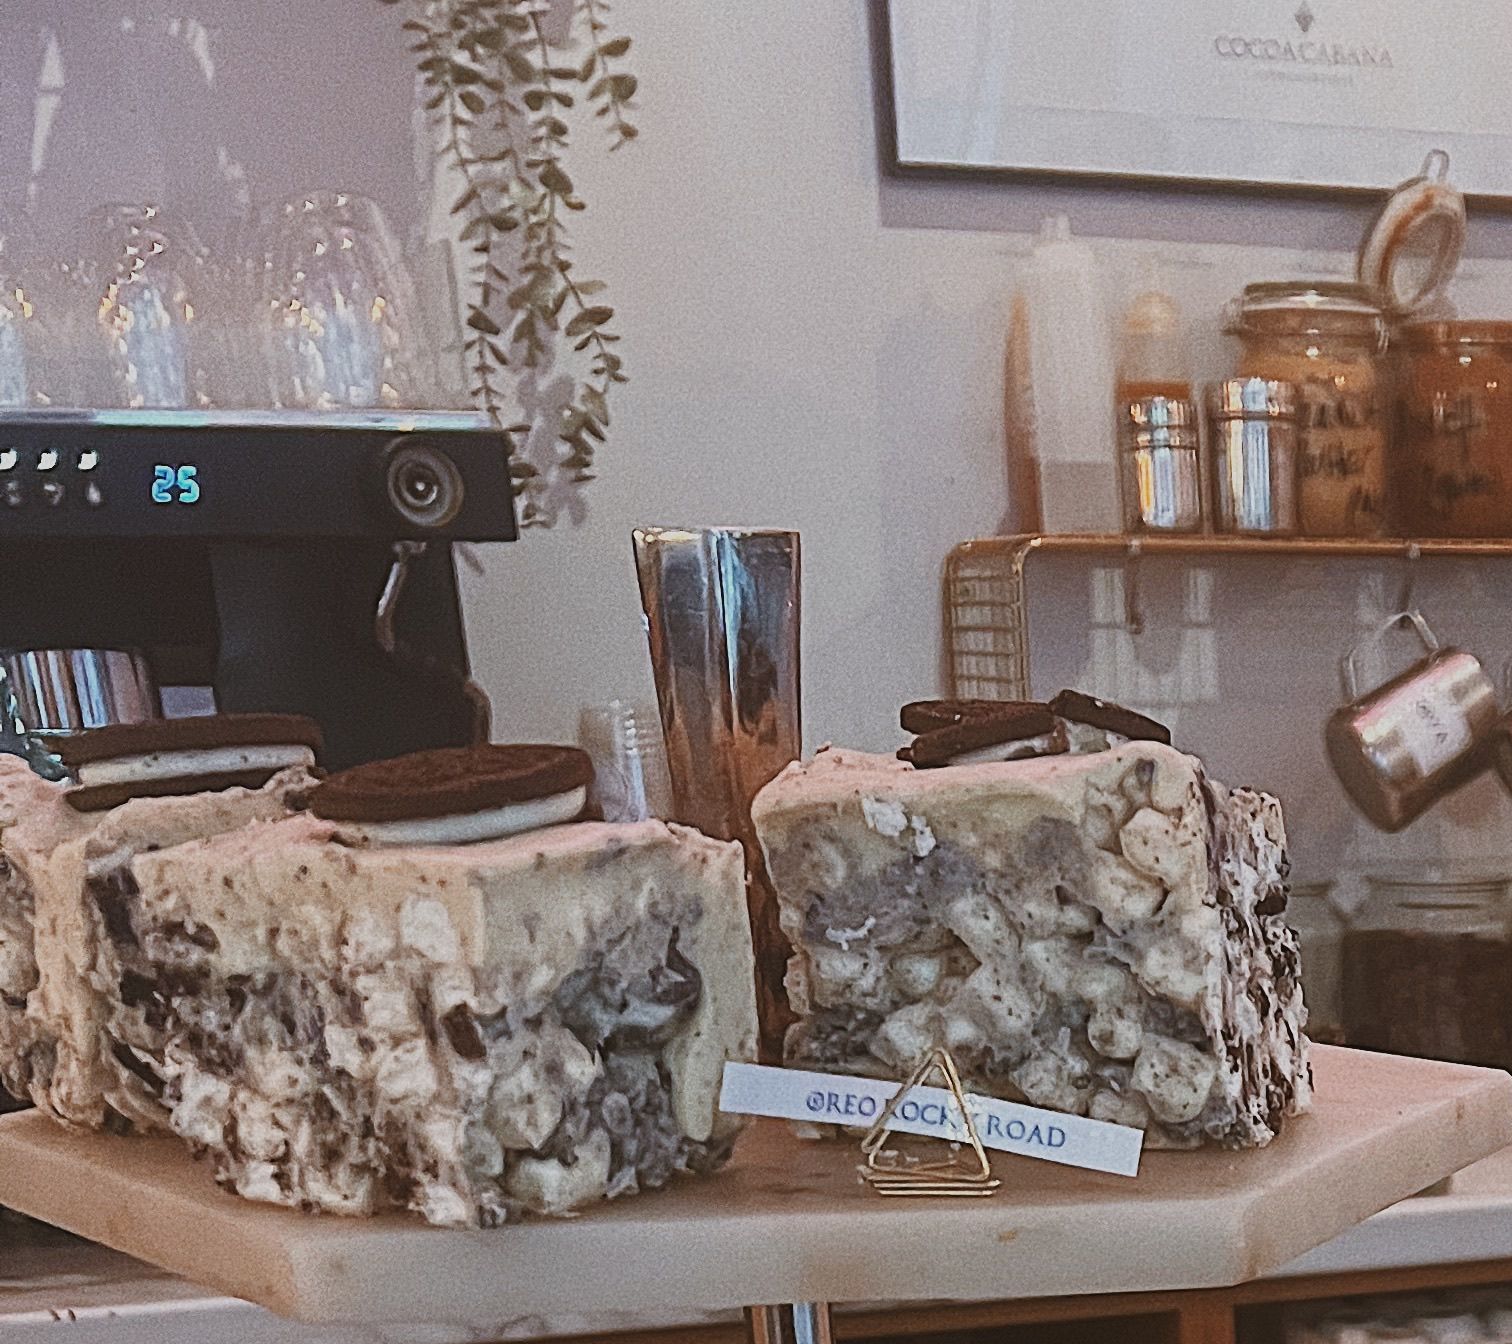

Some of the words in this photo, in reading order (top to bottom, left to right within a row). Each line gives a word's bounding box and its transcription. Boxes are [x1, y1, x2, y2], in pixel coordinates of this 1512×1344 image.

[151, 464, 200, 503] 25
[885, 1098, 980, 1131] OCK
[986, 1114, 1067, 1148] ROAD
